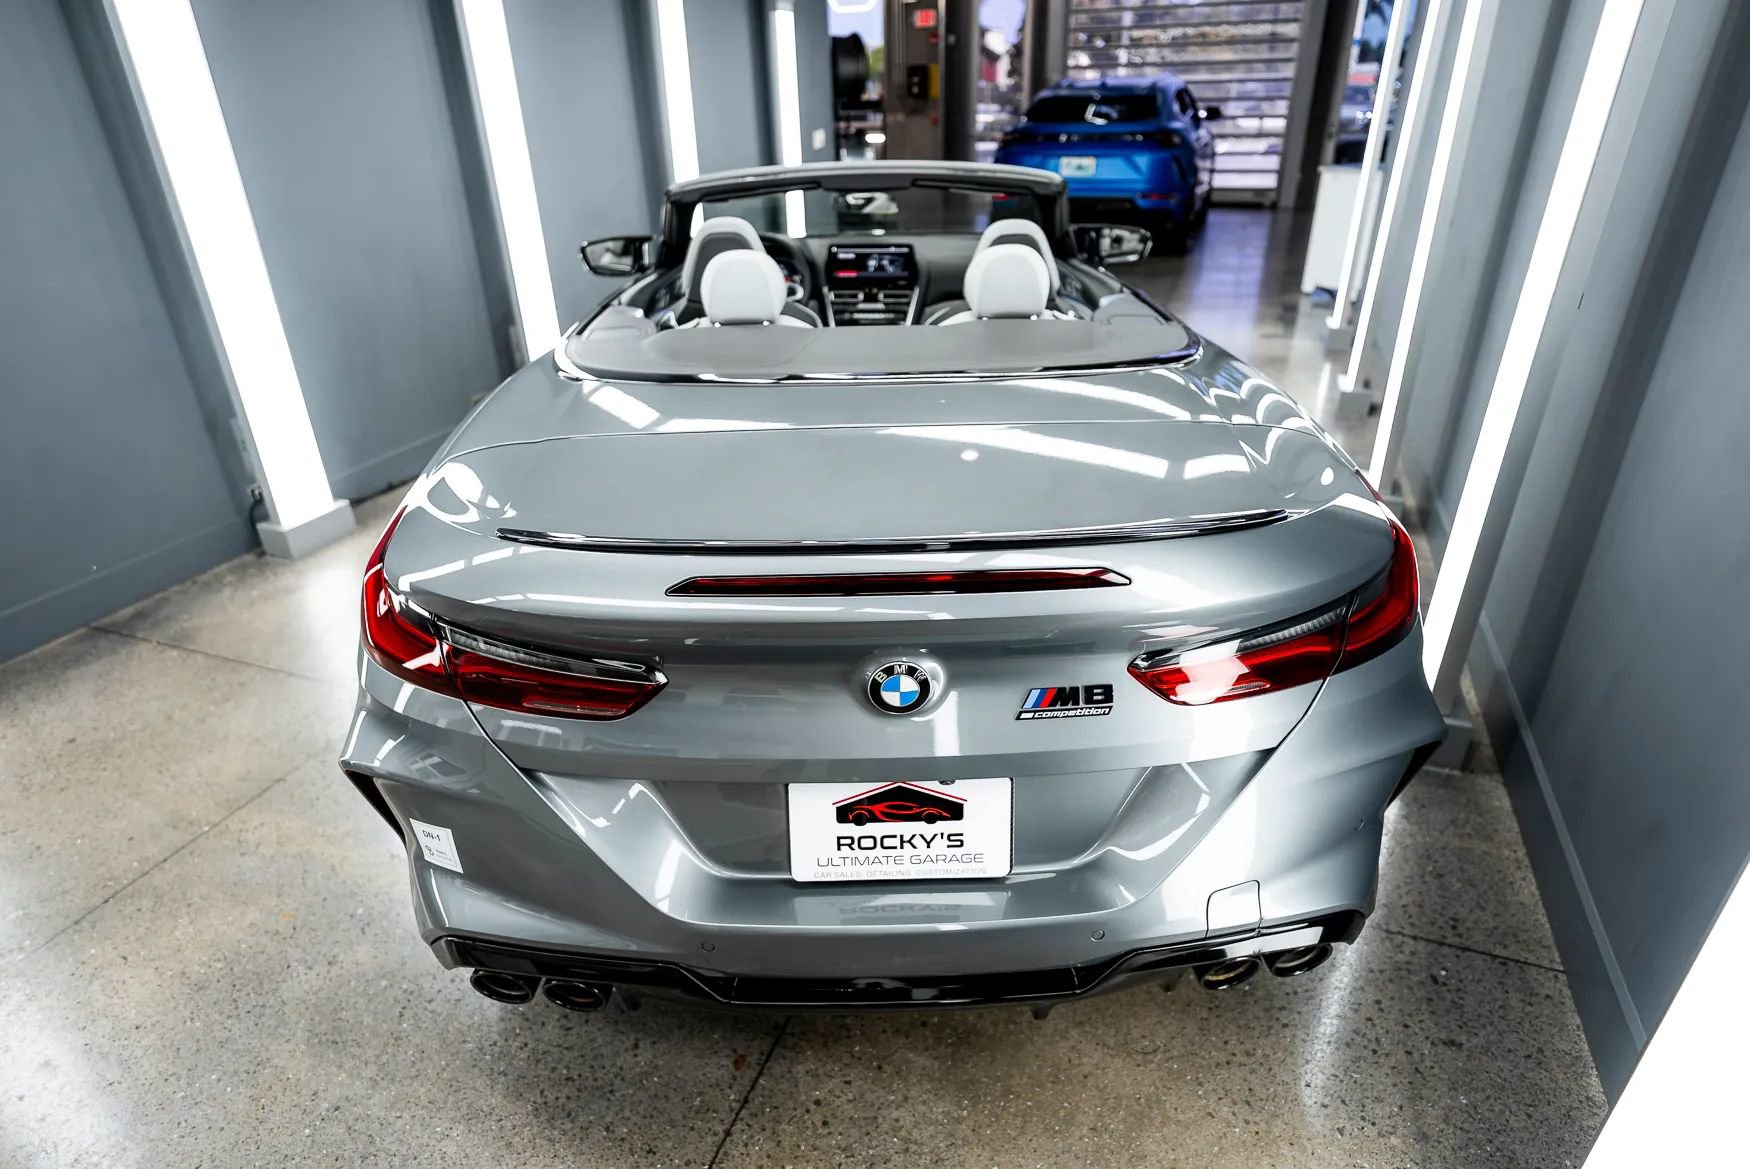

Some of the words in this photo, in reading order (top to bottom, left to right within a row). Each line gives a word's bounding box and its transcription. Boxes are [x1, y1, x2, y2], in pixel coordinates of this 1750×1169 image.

[874, 664, 927, 683] BMW
[1048, 684, 1114, 707] M8
[1034, 707, 1110, 718] competition
[836, 832, 965, 852] ROCKY'S
[816, 855, 905, 868] ULTIMATE
[909, 853, 985, 865] GARAGE
[813, 871, 833, 880] CAR
